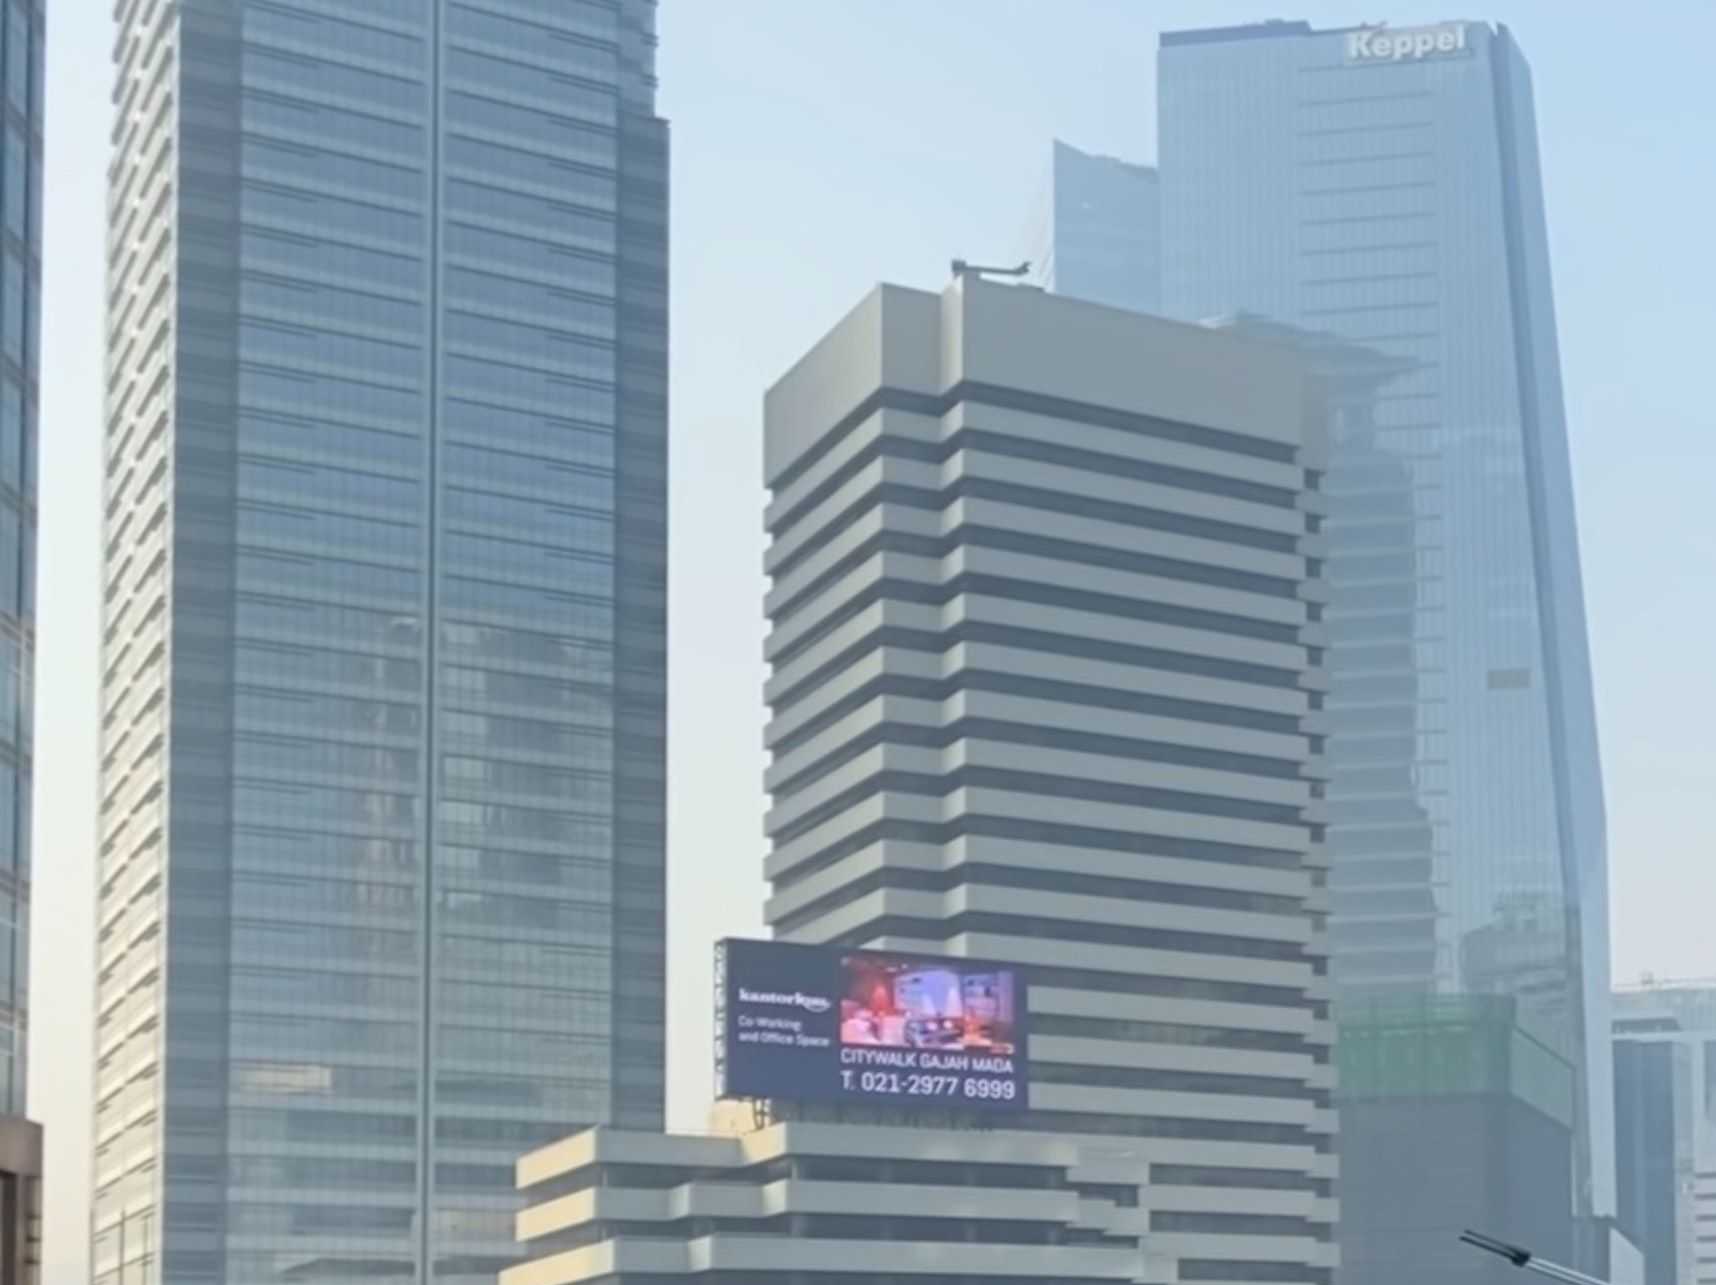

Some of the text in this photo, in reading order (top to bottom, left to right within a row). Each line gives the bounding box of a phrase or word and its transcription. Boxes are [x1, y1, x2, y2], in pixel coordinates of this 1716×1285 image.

[1349, 24, 1465, 60] Keppel
[738, 1032, 830, 1047] and Office Space
[840, 1047, 1014, 1073] CITYWALK GAJAH MADA
[861, 1072, 959, 1096] 021-2977
[964, 1078, 1016, 1099] 6999
